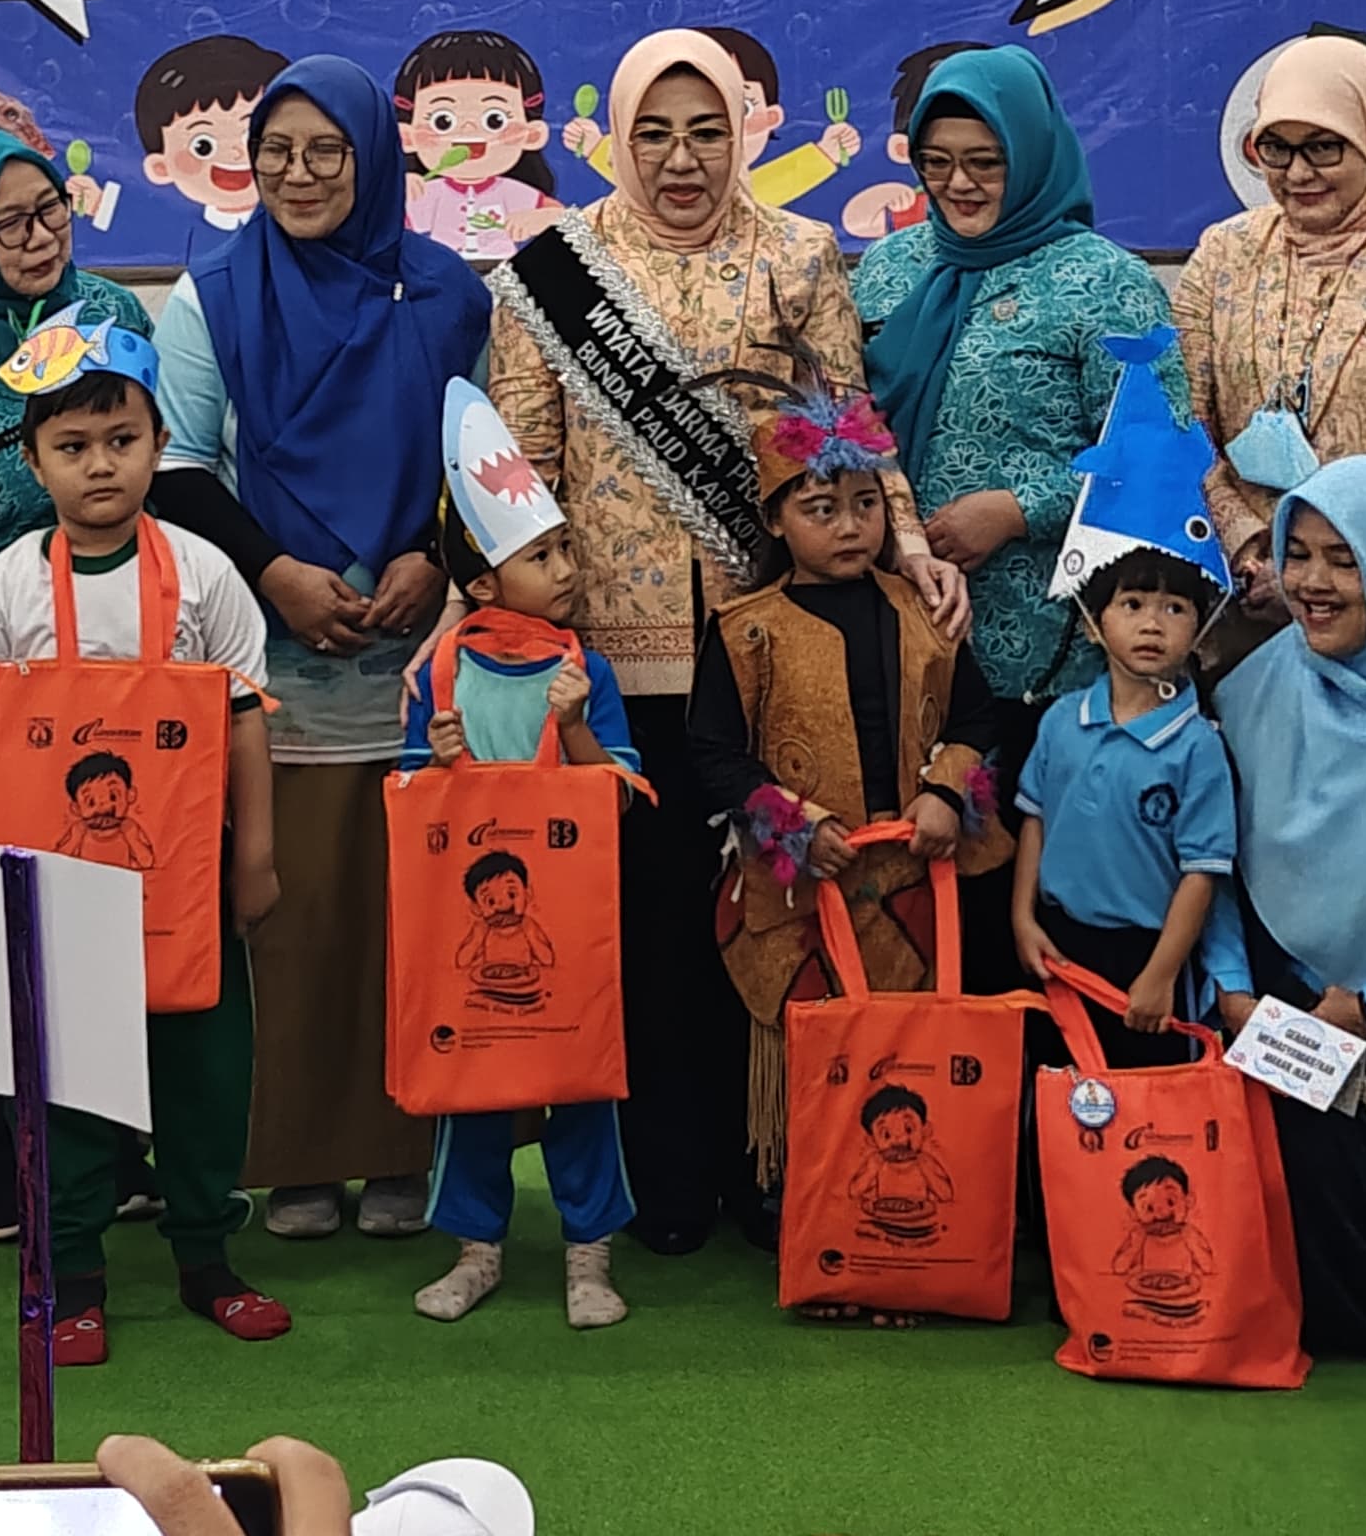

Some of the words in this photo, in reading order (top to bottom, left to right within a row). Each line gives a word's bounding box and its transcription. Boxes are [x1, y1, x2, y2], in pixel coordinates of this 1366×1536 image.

[585, 300, 658, 387] WIYATA
[576, 340, 634, 409] BUNDA
[631, 407, 688, 462] PAUD
